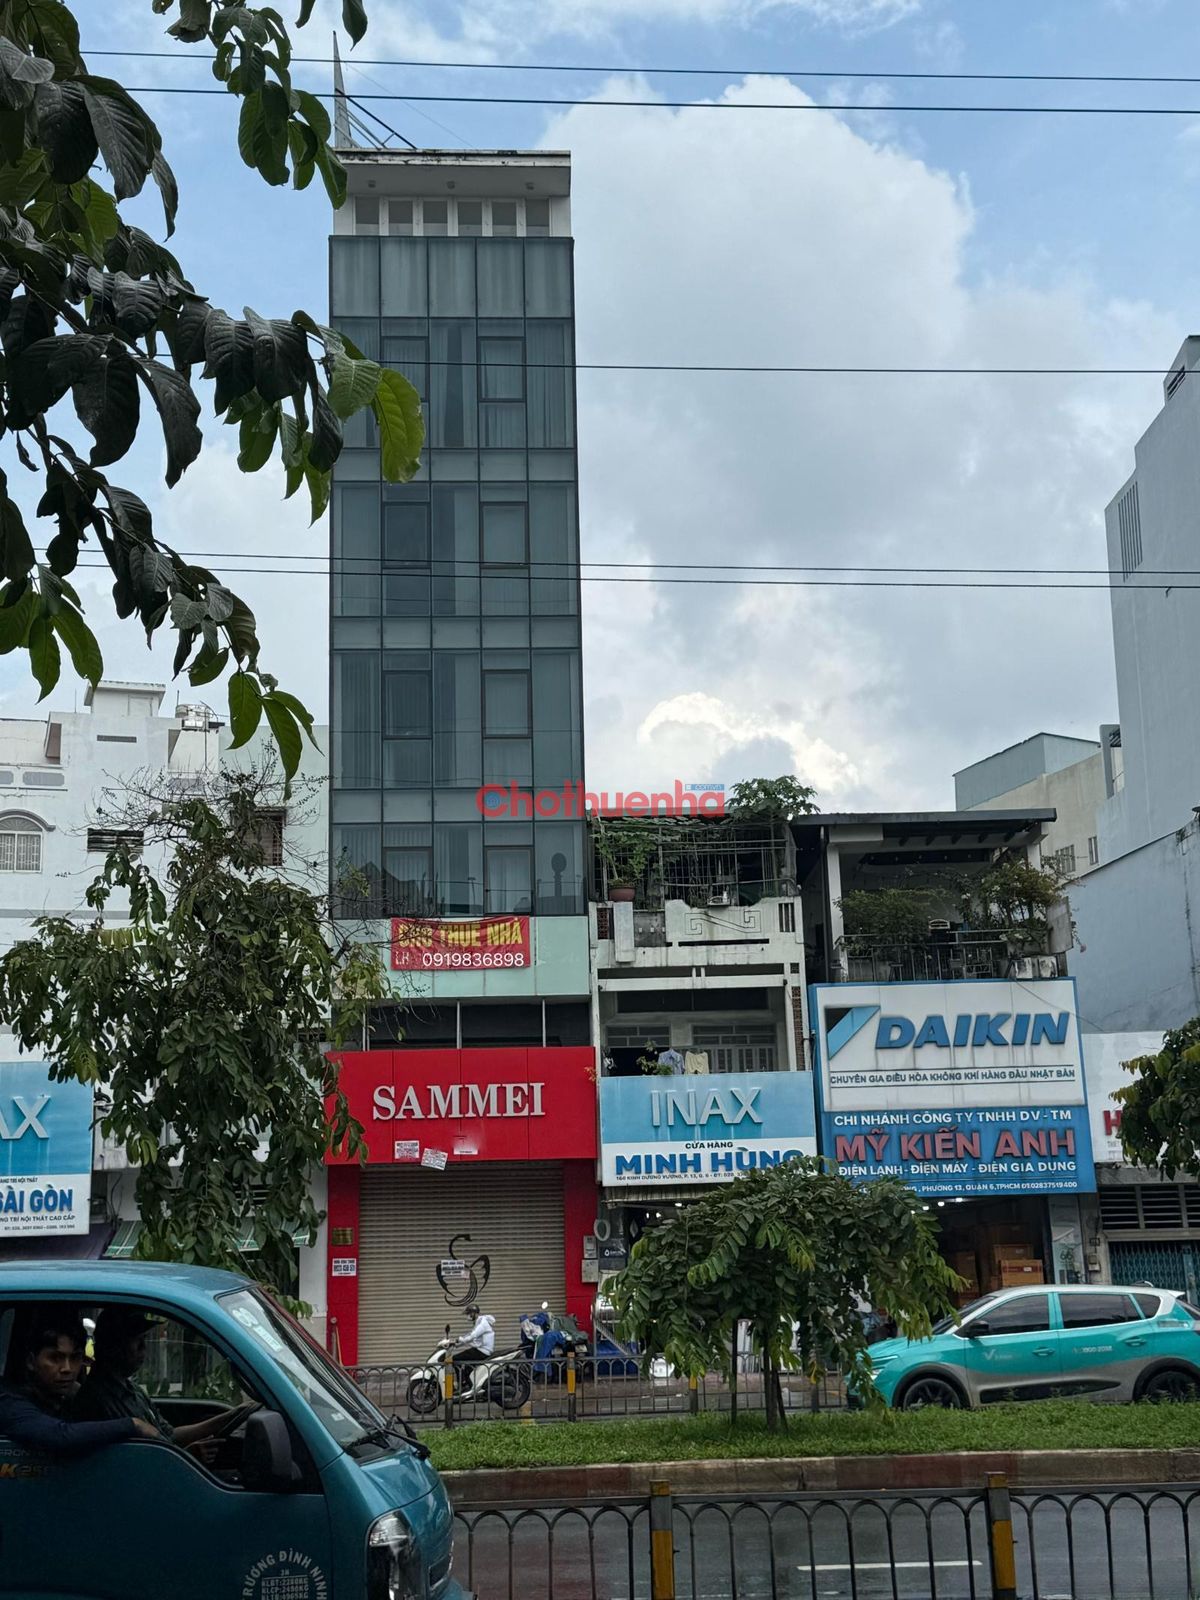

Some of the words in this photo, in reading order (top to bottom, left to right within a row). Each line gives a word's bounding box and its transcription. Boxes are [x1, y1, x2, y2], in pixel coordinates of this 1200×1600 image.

[487, 917, 523, 946] NHÀ
[422, 952, 524, 967] 0919836898
[875, 1012, 1070, 1049] DAIKIN
[830, 1073, 866, 1084] CHUYÊN
[869, 1075, 884, 1083] GIA
[909, 1071, 928, 1081] HÒA
[930, 1071, 961, 1081] KHÔNG
[964, 1071, 979, 1080] KHÍ
[981, 1070, 1006, 1080] HÀNG
[1030, 1069, 1054, 1080] NHẬT
[373, 1082, 545, 1121] SAMMEI
[651, 1087, 763, 1126] INAX
[834, 1115, 857, 1126] CHI
[861, 1112, 909, 1125] NHÁNH
[913, 1111, 952, 1124] CÔNG
[955, 1112, 973, 1122] TY
[977, 1111, 1016, 1122] TNHH
[1020, 1110, 1041, 1121] DV
[1050, 1110, 1072, 1120] TM
[685, 1141, 705, 1149] CỬA
[835, 1128, 889, 1162] MỸ
[900, 1126, 981, 1160] KIẾN
[995, 1129, 1075, 1158] ANH
[615, 1153, 702, 1175] MINH
[839, 1164, 867, 1178] ĐIỆN
[870, 1165, 903, 1176] LẠNH
[910, 1162, 939, 1176] ĐIỆN
[942, 1161, 968, 1174] MÁY
[979, 1161, 1008, 1175] ĐIỆN
[1011, 1162, 1034, 1172] GIA
[1038, 1161, 1076, 1174] DỤNG
[30, 1184, 73, 1213] GÒN
[242, 1554, 276, 1600] RƯƠNG
[279, 1547, 312, 1569] ĐÌNH
